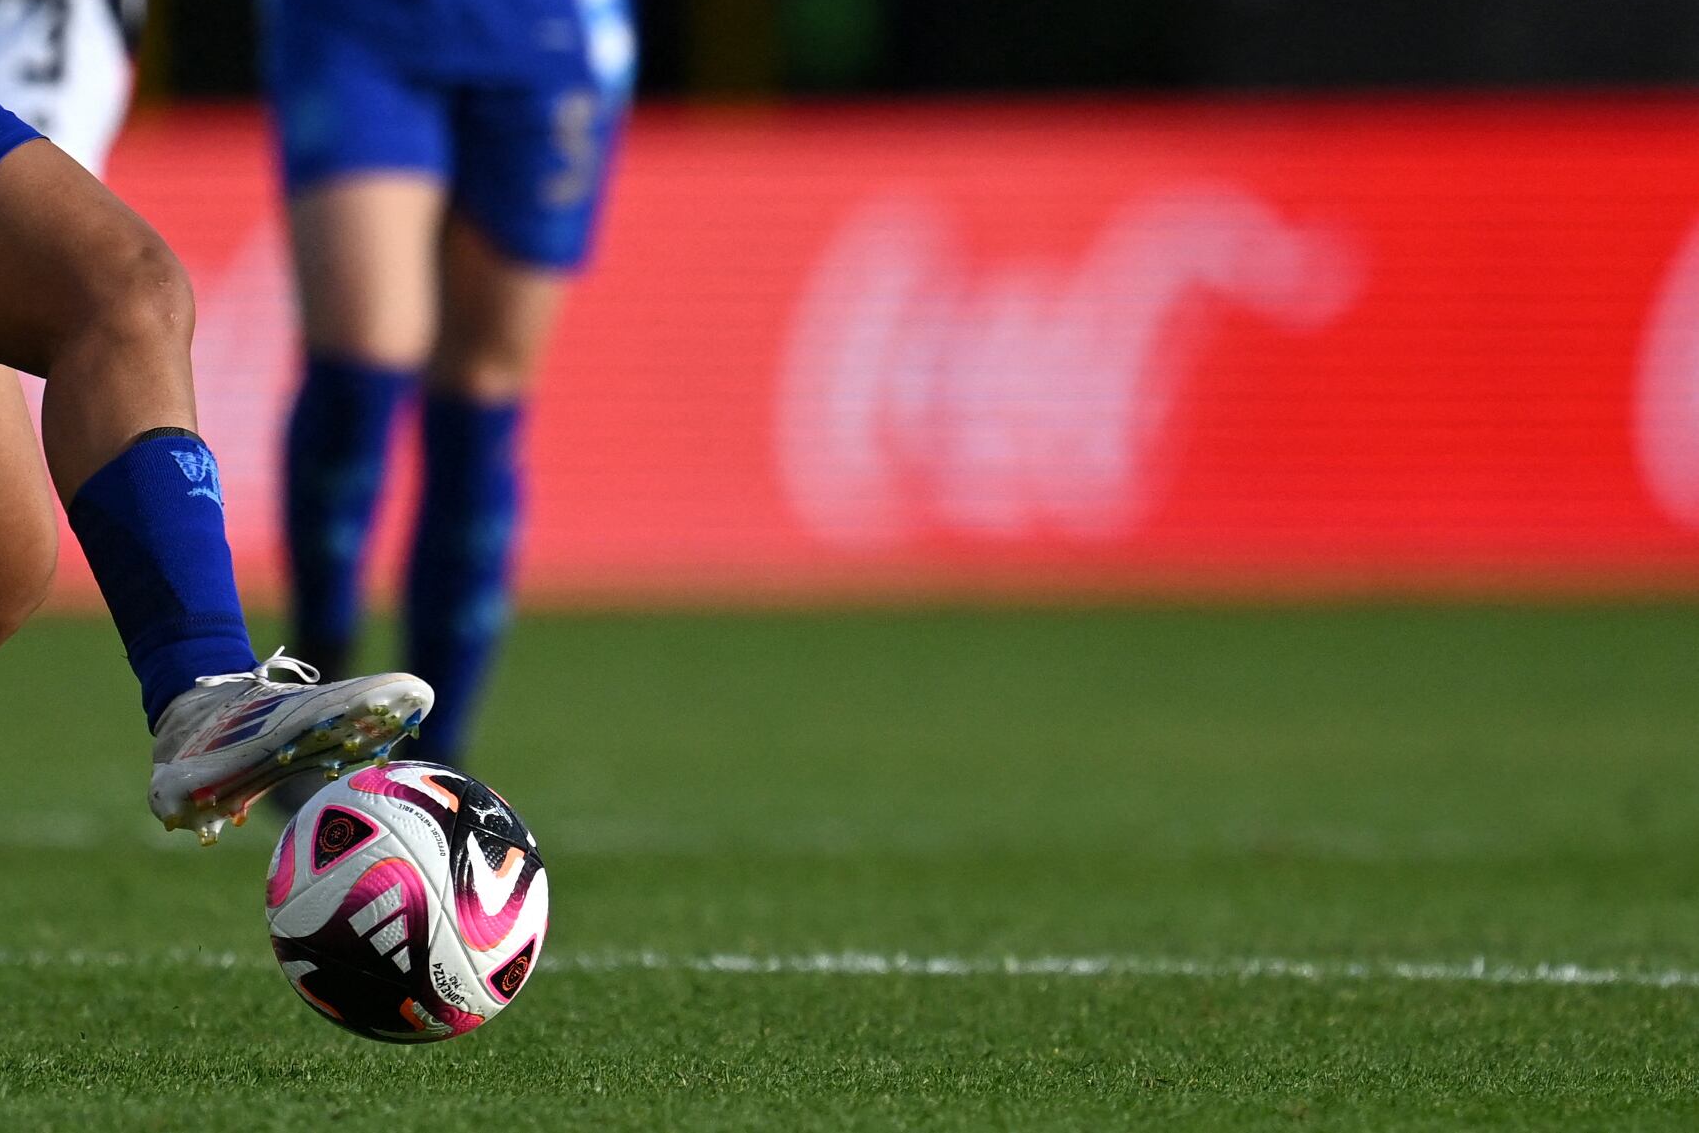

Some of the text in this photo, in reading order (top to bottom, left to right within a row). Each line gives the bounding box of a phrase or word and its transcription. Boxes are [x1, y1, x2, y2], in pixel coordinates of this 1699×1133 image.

[398, 803, 446, 857] OFFICIAL MATCH BALL
